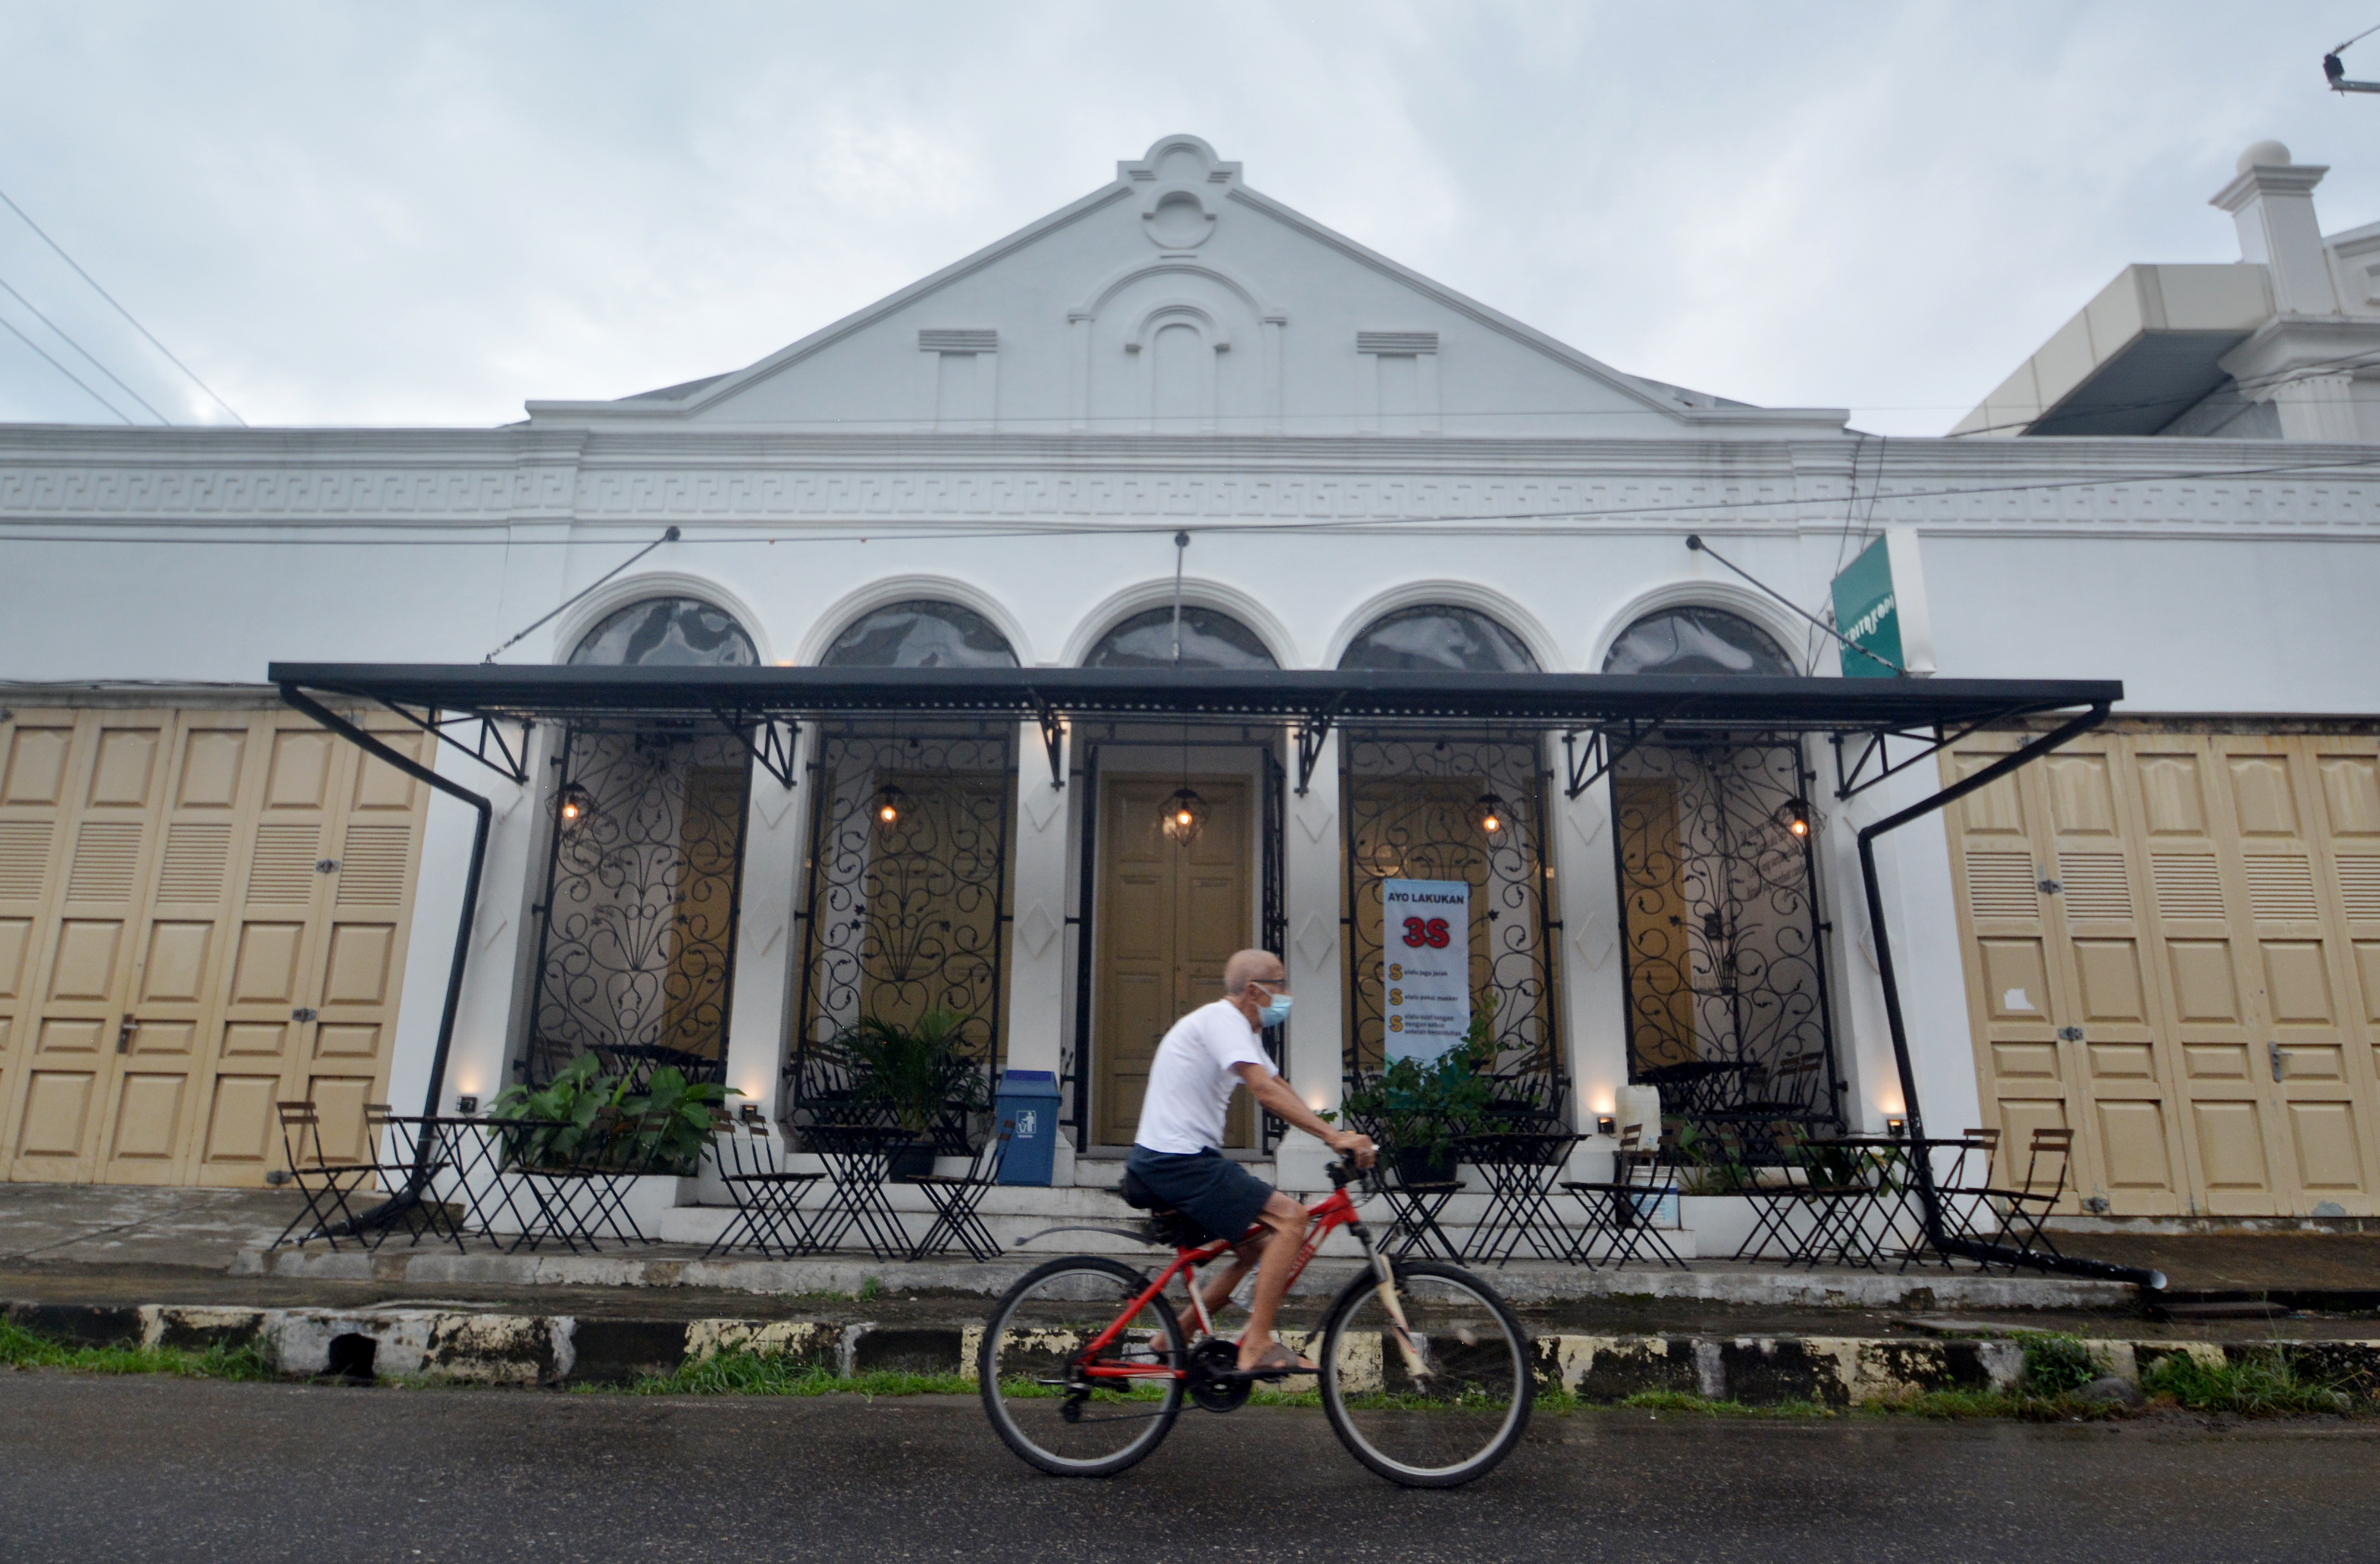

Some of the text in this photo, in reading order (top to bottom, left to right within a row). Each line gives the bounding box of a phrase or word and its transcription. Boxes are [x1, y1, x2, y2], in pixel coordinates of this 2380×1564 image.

[1388, 892, 1464, 904] AYO LAKUKAN
[1402, 916, 1450, 949] 3S
